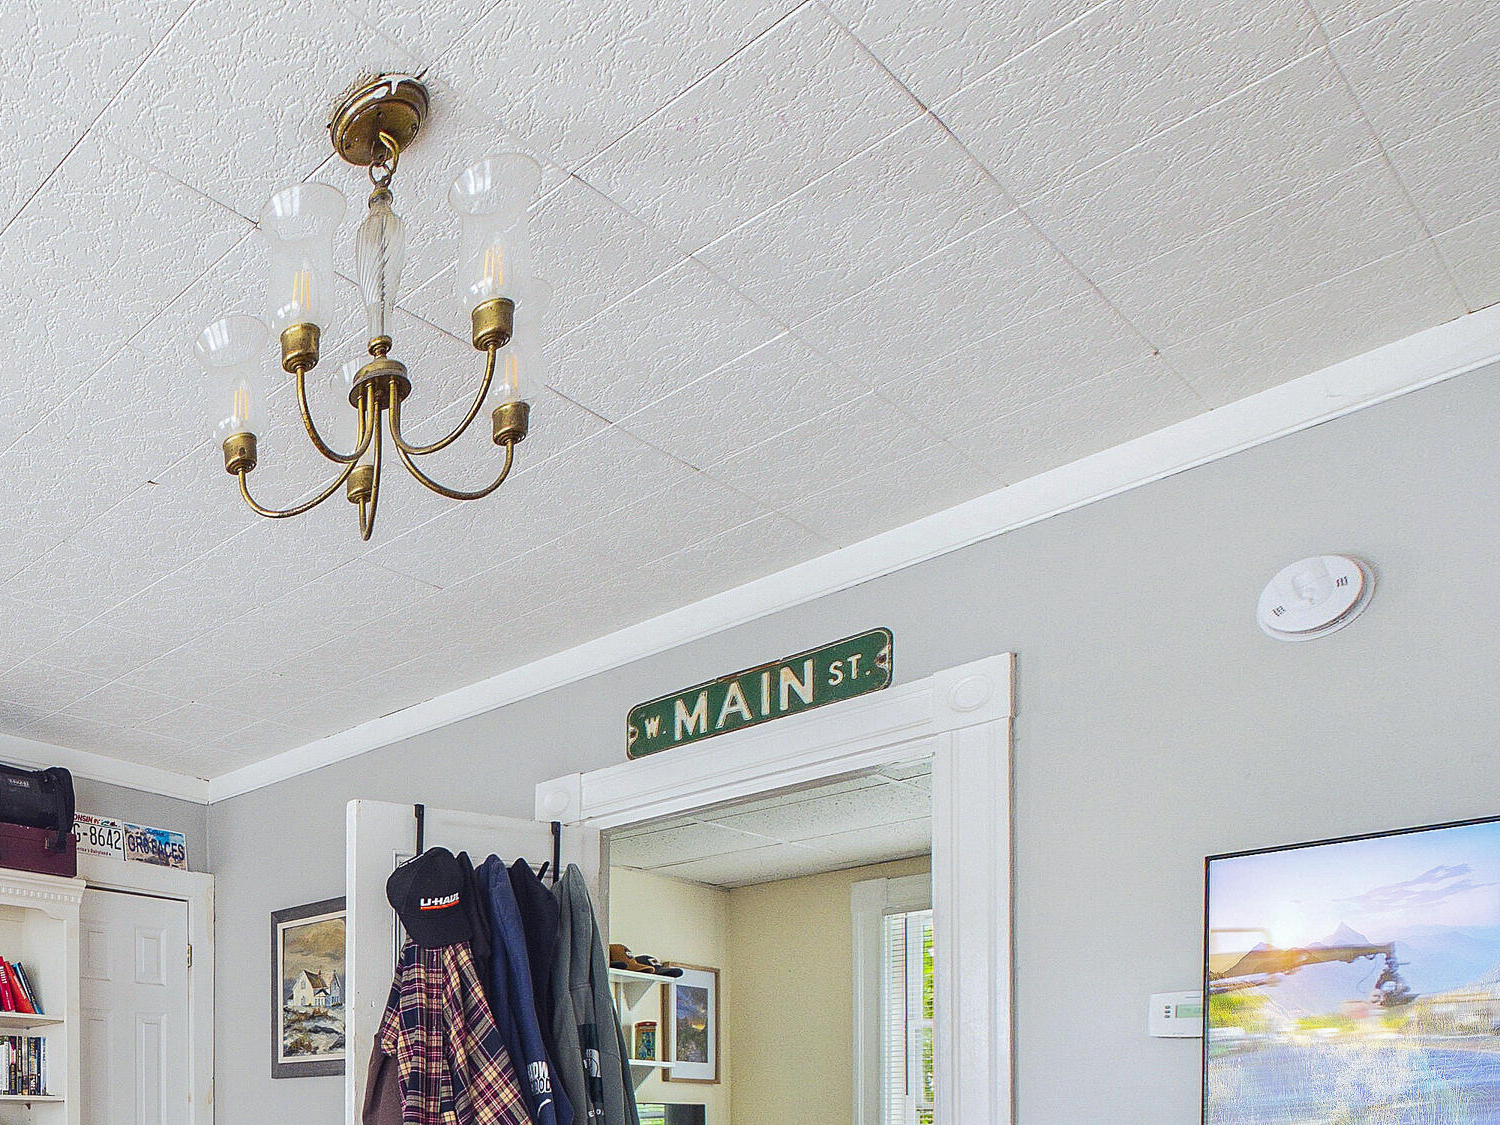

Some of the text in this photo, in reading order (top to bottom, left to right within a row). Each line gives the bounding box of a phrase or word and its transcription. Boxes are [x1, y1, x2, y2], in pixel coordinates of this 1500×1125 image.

[644, 653, 871, 741] W. MAIN ST.
[420, 892, 460, 907] U-HAUL
